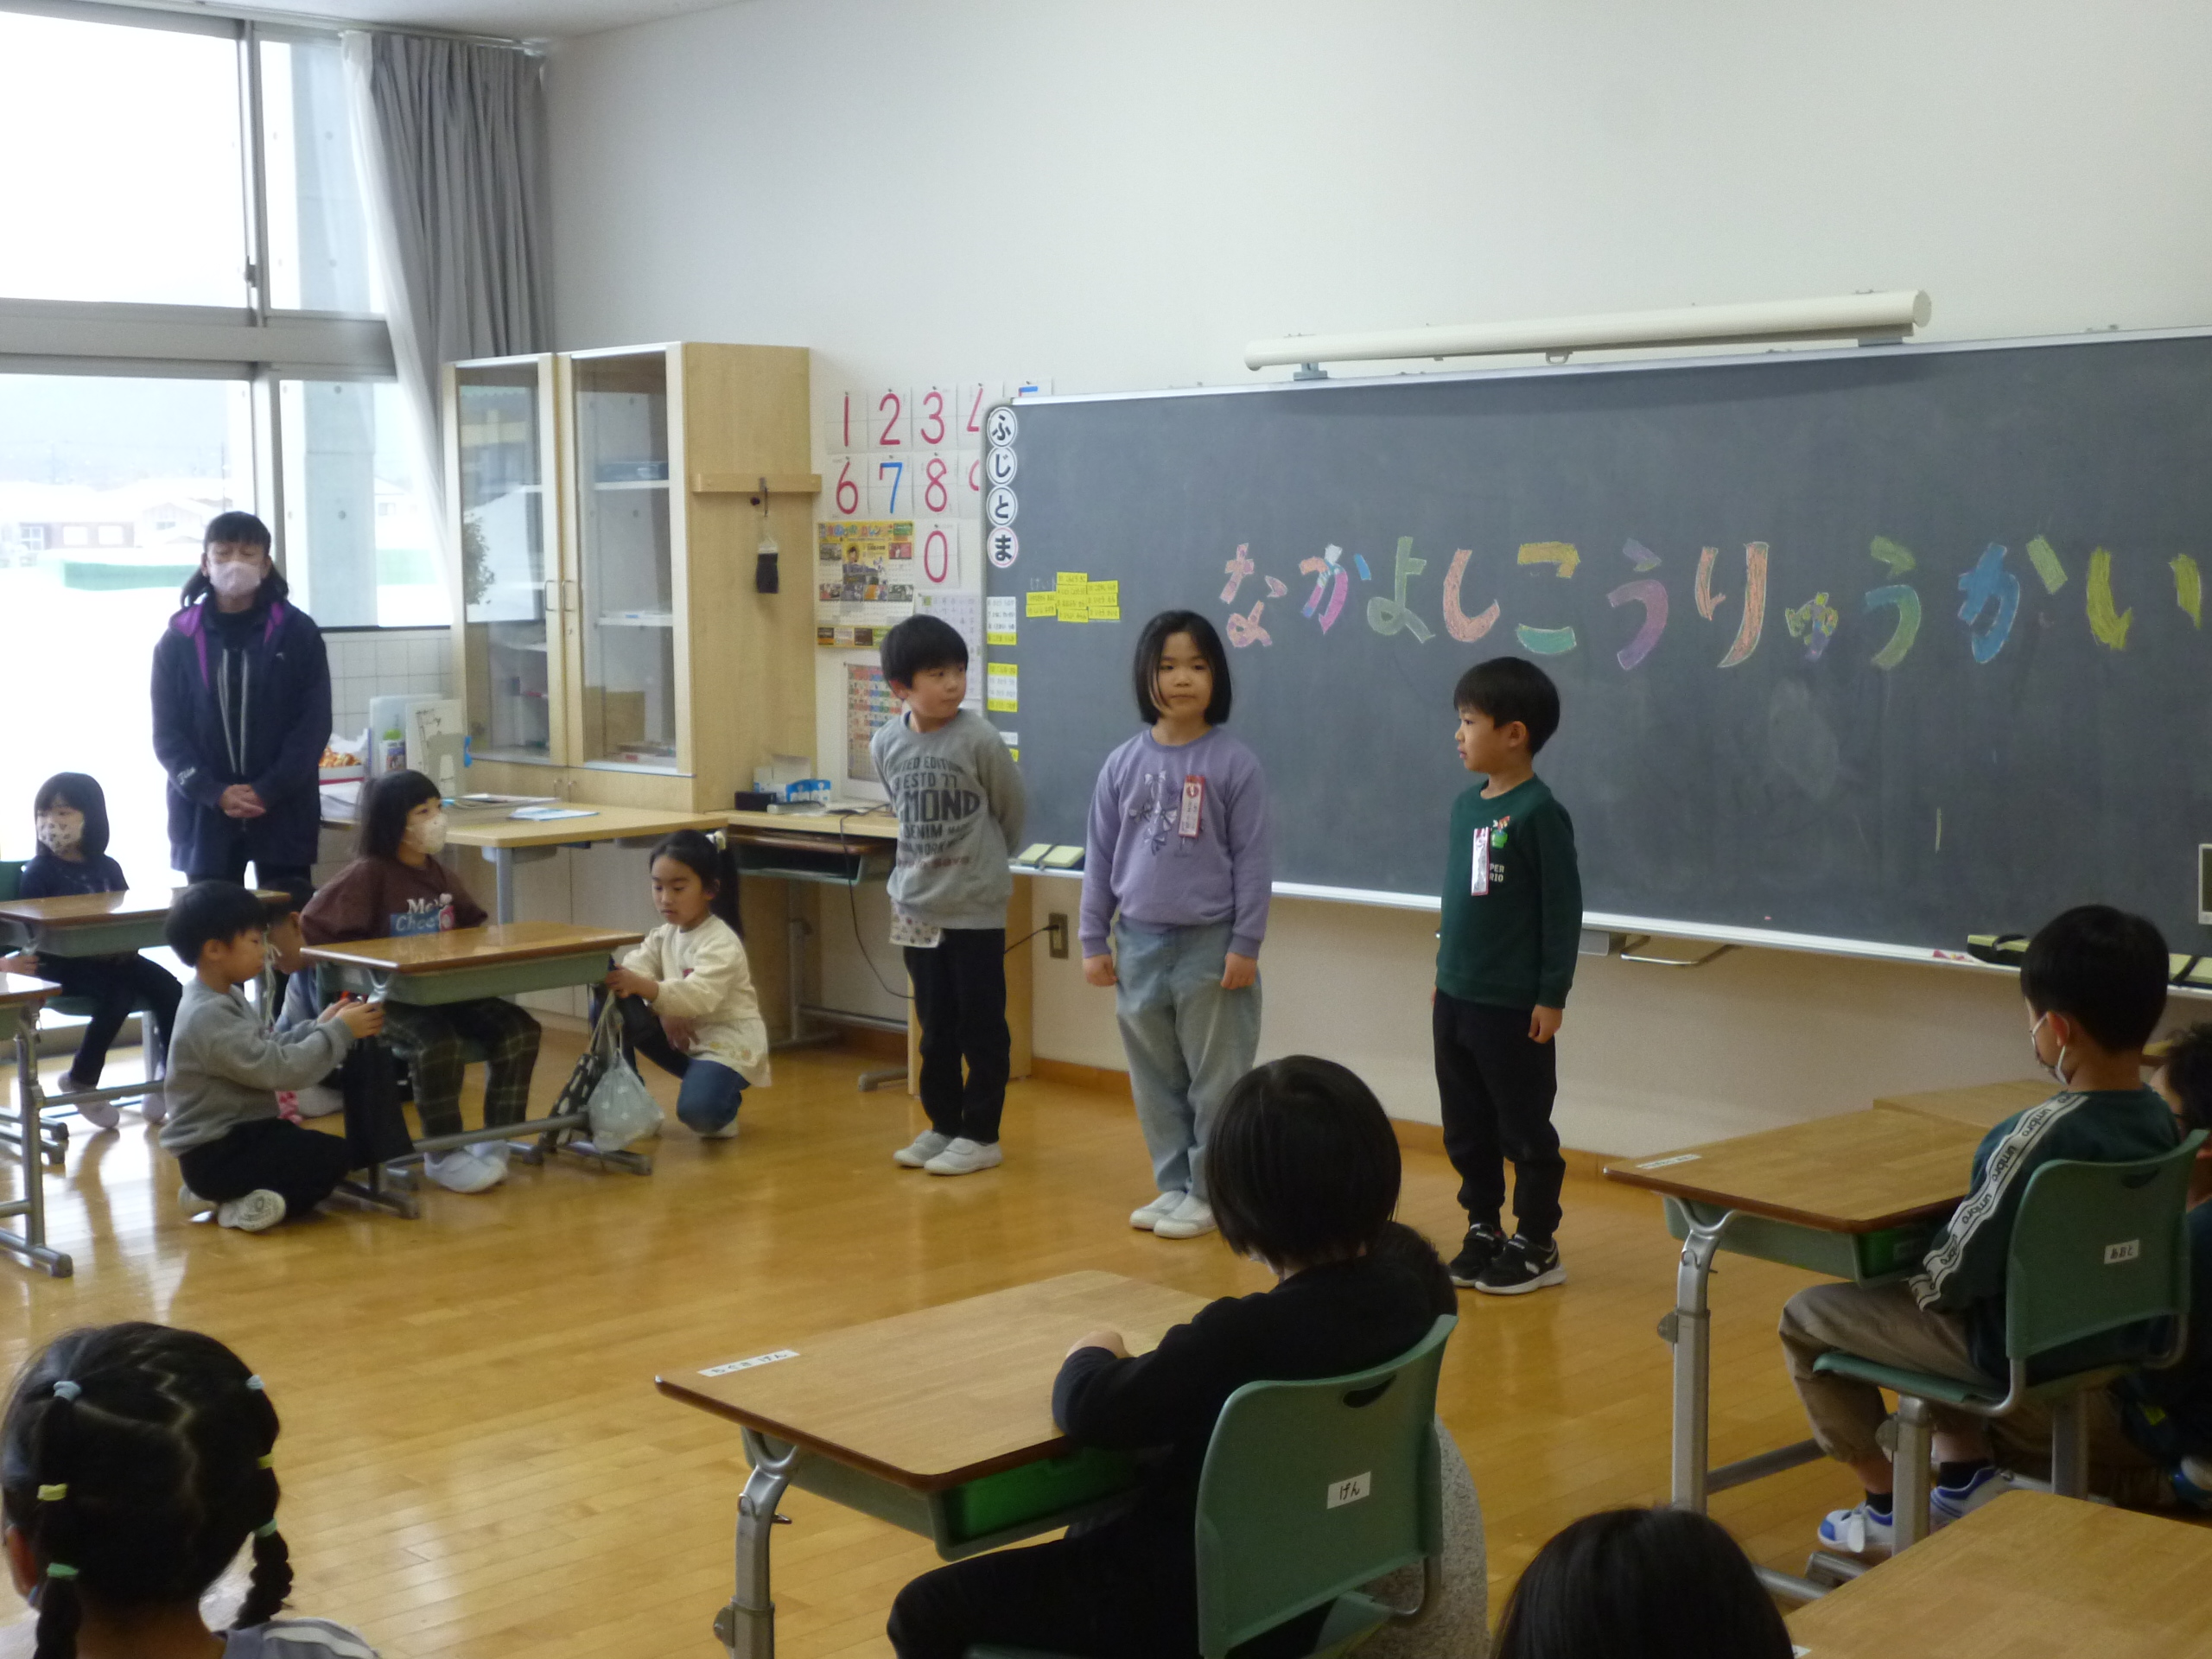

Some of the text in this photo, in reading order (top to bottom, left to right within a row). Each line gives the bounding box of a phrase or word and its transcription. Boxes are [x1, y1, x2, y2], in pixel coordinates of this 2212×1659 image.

[844, 395, 849, 447] 1
[879, 392, 901, 446] 2
[920, 391, 945, 445] 3
[836, 461, 859, 515] 6
[879, 461, 903, 514] 7
[924, 457, 948, 512] 8
[924, 530, 949, 583] 0
[1219, 532, 2203, 671] なかよしこうりゅうかい
[903, 772, 957, 789] ESTD 77
[903, 788, 981, 823] MOND
[1489, 862, 1504, 873] PER
[1489, 873, 1504, 882] RIO
[2021, 1108, 2052, 1137] umbro
[1992, 1145, 2018, 1182] umbro
[1961, 1193, 1993, 1224] umbro
[1339, 1481, 1360, 1501] げん
